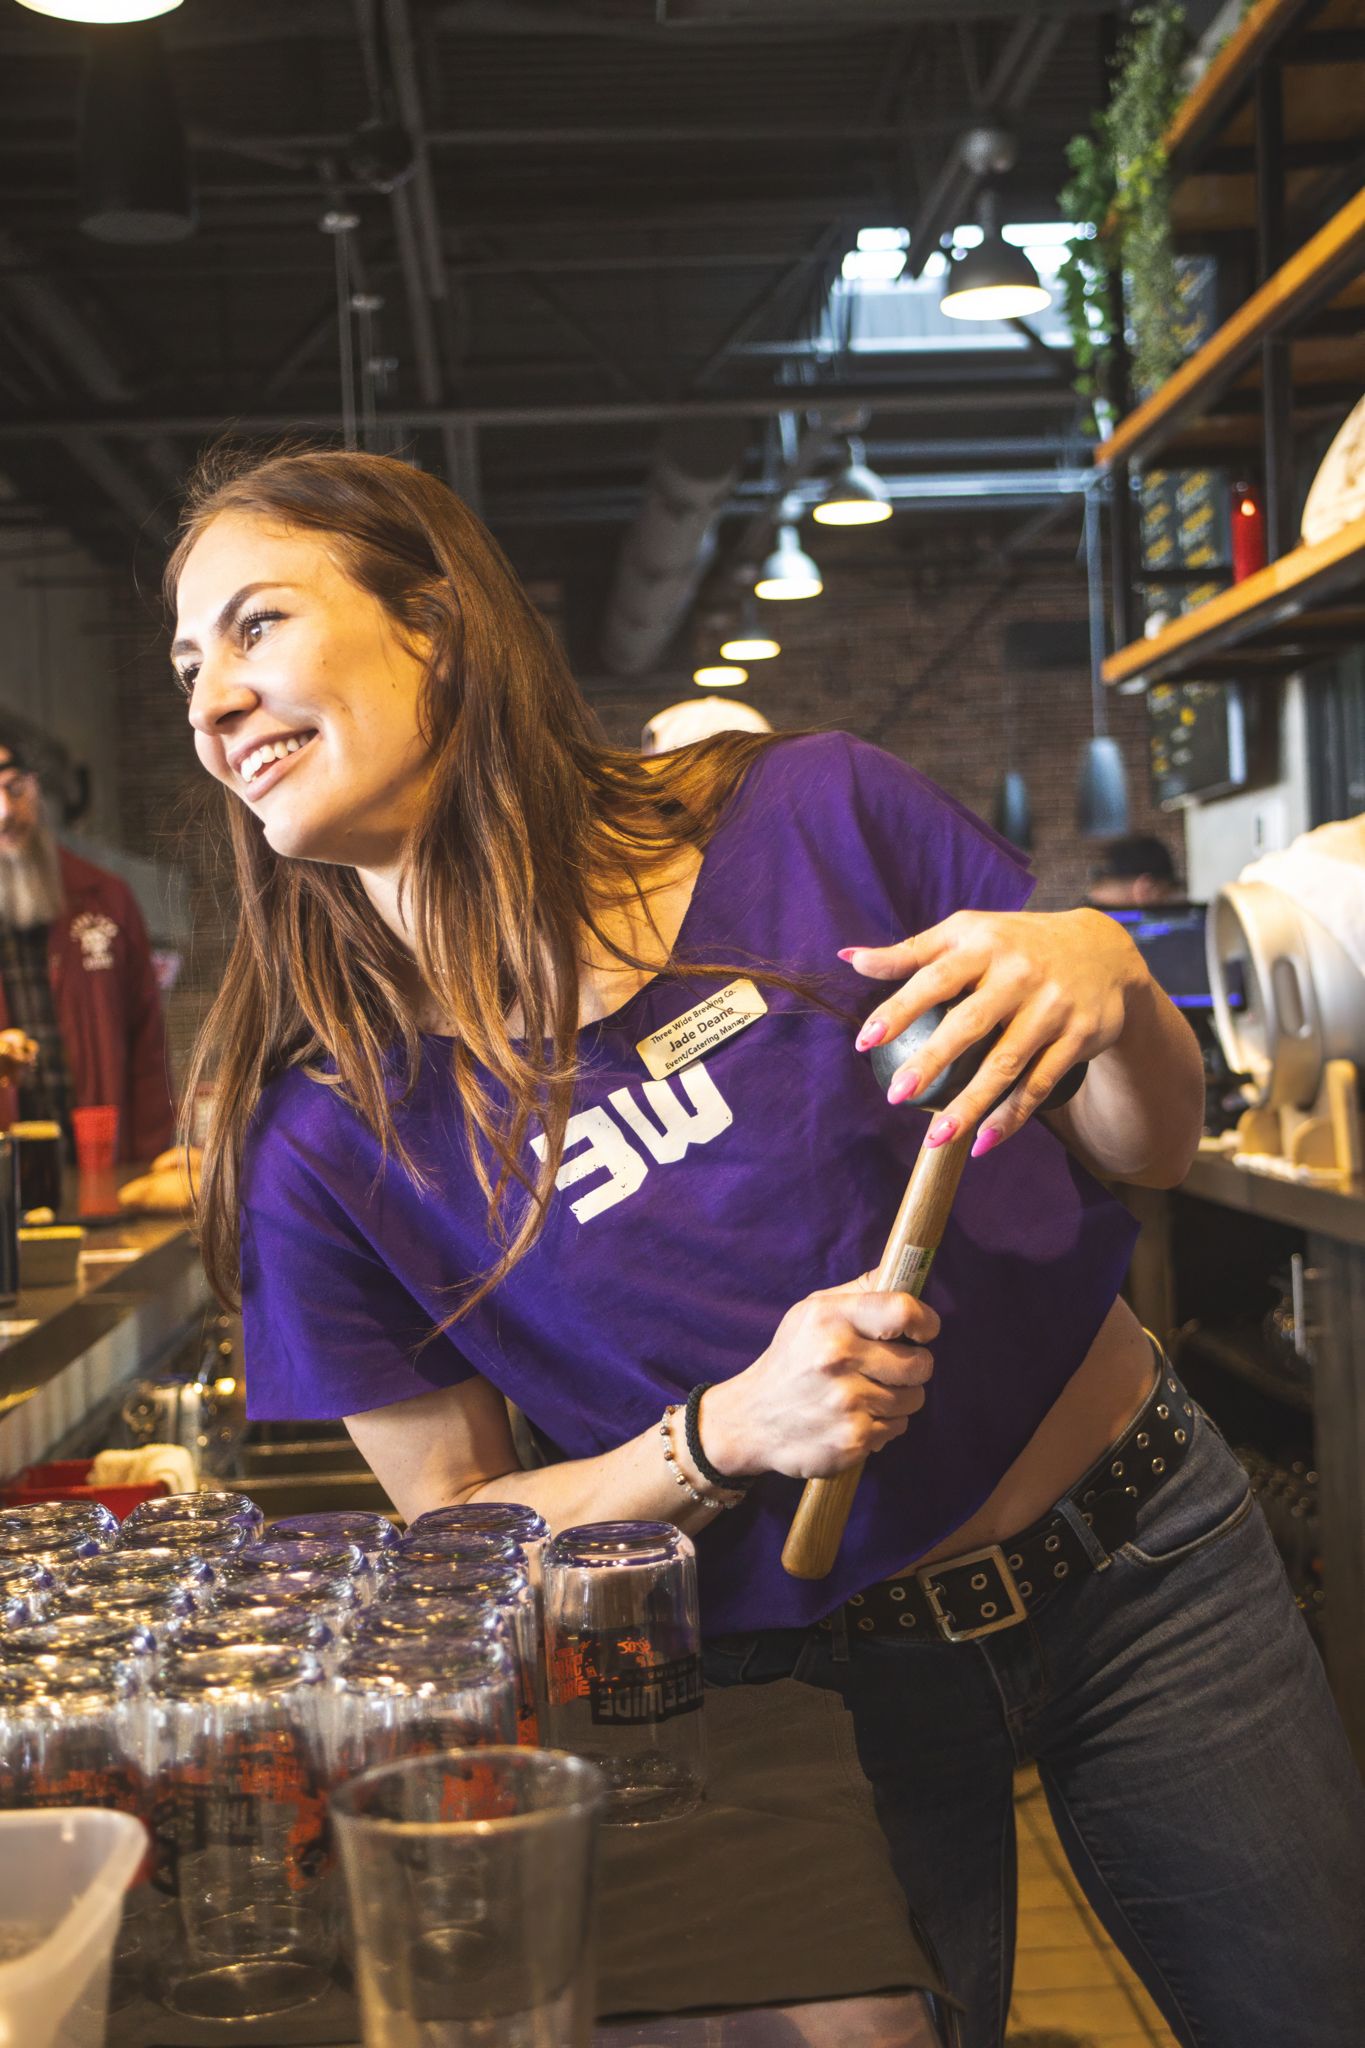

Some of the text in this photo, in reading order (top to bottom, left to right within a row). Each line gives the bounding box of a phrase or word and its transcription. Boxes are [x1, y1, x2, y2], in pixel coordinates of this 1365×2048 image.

[650, 989, 737, 1044] Three Wide Brewing Co.
[665, 1012, 752, 1070] Event/Catering Manager
[669, 1006, 734, 1052] Jade Deane
[529, 1060, 734, 1225] 3W
